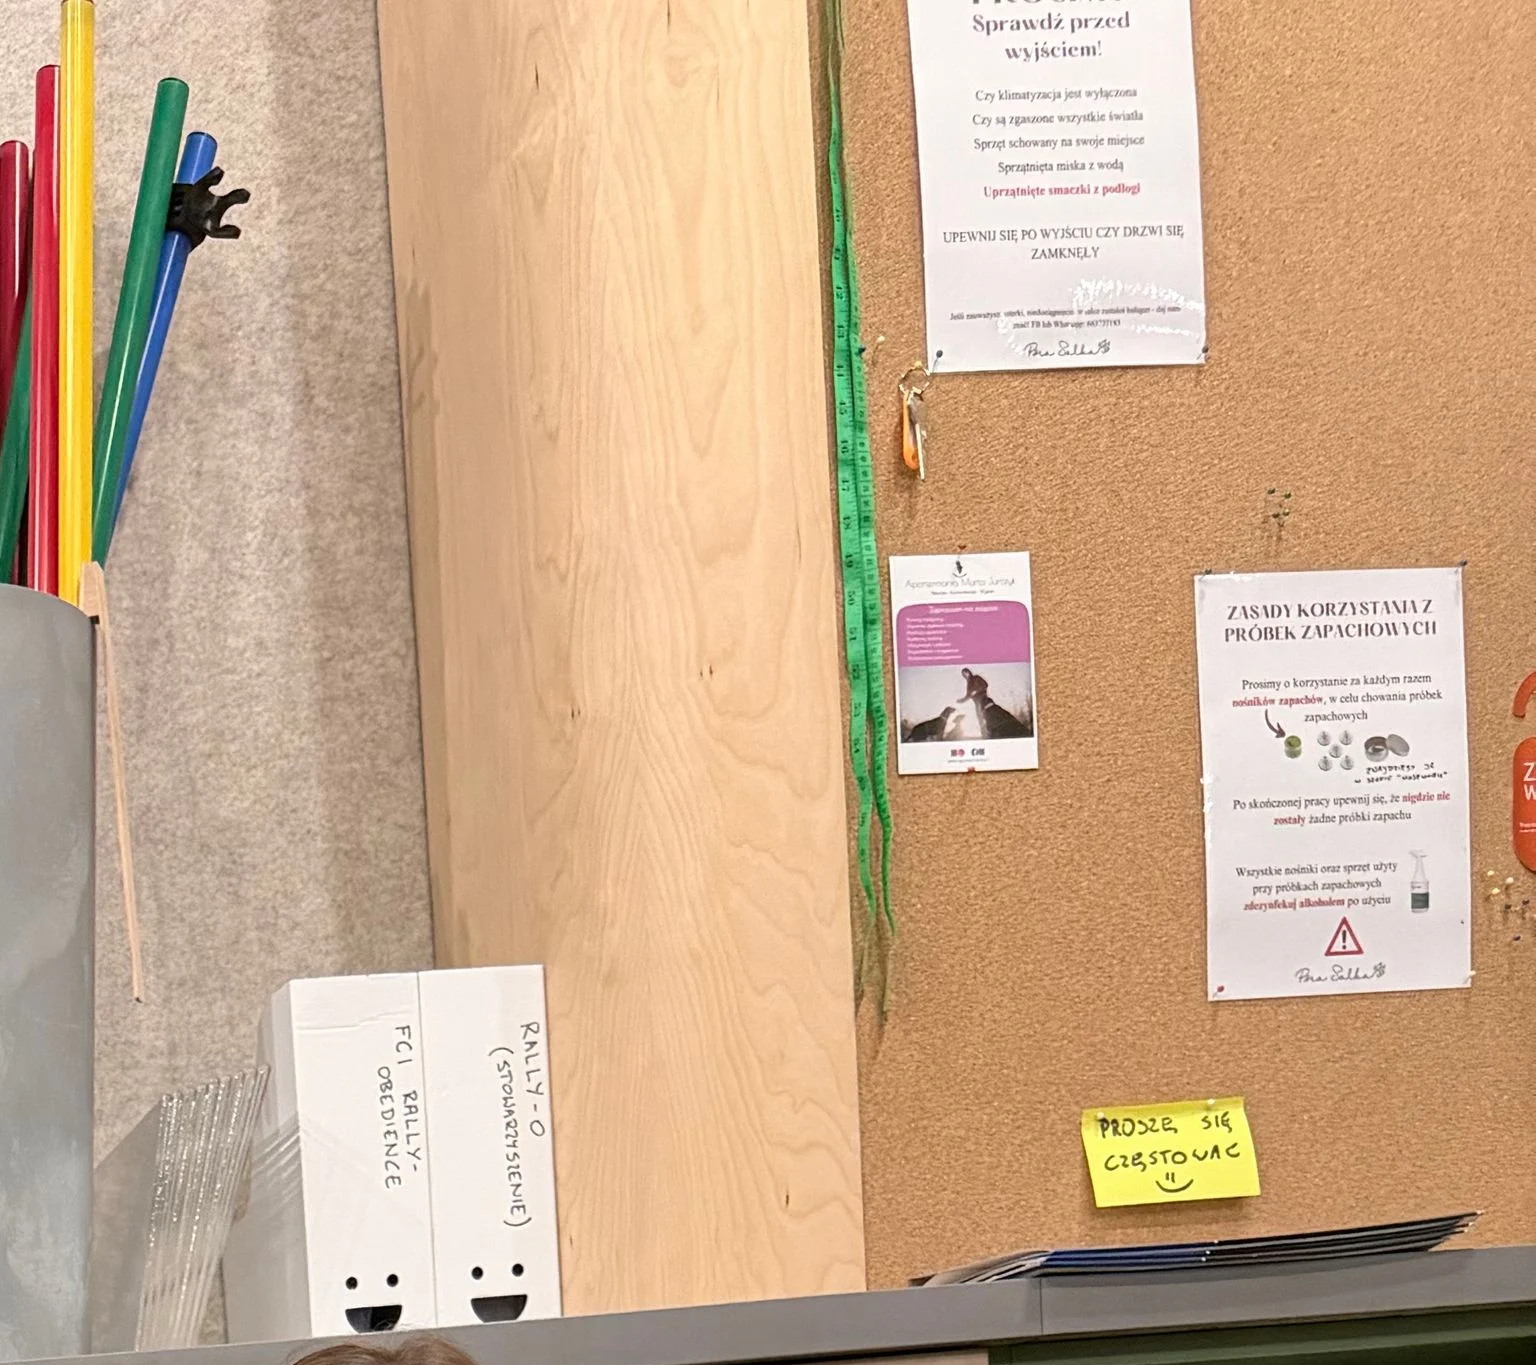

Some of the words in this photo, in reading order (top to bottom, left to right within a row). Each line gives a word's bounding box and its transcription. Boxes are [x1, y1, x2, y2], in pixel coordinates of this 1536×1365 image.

[972, 12, 1064, 36] Sprawdź
[1070, 11, 1130, 34] przed
[1005, 40, 1102, 62] wyjściem!
[975, 90, 995, 104] Czy
[998, 89, 1062, 103] klimatyzacja
[1063, 88, 1082, 102] jest
[972, 113, 992, 127] Czy
[1009, 115, 1054, 127] zgaszone
[1057, 111, 1106, 125] wszystkie
[973, 138, 1006, 151] Sprzęt
[1008, 137, 1058, 150] schowany
[1061, 138, 1072, 147] na
[1075, 135, 1105, 148] swoje
[1107, 134, 1145, 147] miejsce
[1056, 160, 1086, 172] miska
[1089, 162, 1095, 170] z
[1048, 184, 1091, 196] smaczki
[1094, 187, 1099, 195] z
[943, 230, 996, 244] UPEWNIJ
[1021, 229, 1037, 241] PO
[1095, 226, 1120, 238] CZY
[1123, 225, 1163, 237] DRZWI
[1227, 604, 1293, 620] ZASADY
[1297, 600, 1419, 618] KORZYSTANIA
[1422, 599, 1434, 614] Z
[1224, 624, 1296, 643] PRÓBEK
[1301, 620, 1437, 640] ZAPACHOWYCH
[1241, 679, 1282, 692] Prosimy
[1292, 677, 1348, 691] korzystanie
[1350, 677, 1361, 686] za
[1363, 674, 1400, 688] każdym
[1403, 675, 1432, 685] razem
[1339, 694, 1359, 704] celu
[1361, 691, 1406, 703] chowania
[1409, 689, 1443, 703] próbek
[1304, 710, 1368, 724] zapachowych
[1233, 799, 1247, 810] Po
[1248, 796, 1302, 810] skończonej
[1304, 798, 1330, 809] pracy
[1333, 793, 1370, 807] upewnij
[1338, 810, 1371, 825] próbki
[1373, 810, 1412, 823] zapachu
[1235, 865, 1282, 878] Wszystkie
[1320, 865, 1341, 874] oraz
[1252, 885, 1273, 896] przy
[1275, 880, 1319, 895] próbkach
[1321, 878, 1382, 892] zapachowych
[1347, 897, 1359, 908] po
[1361, 894, 1391, 906] użyciu
[394, 1024, 412, 1065] FCI
[377, 1066, 402, 1190] OBEDIENCE
[1201, 1111, 1233, 1133] SIĘ
